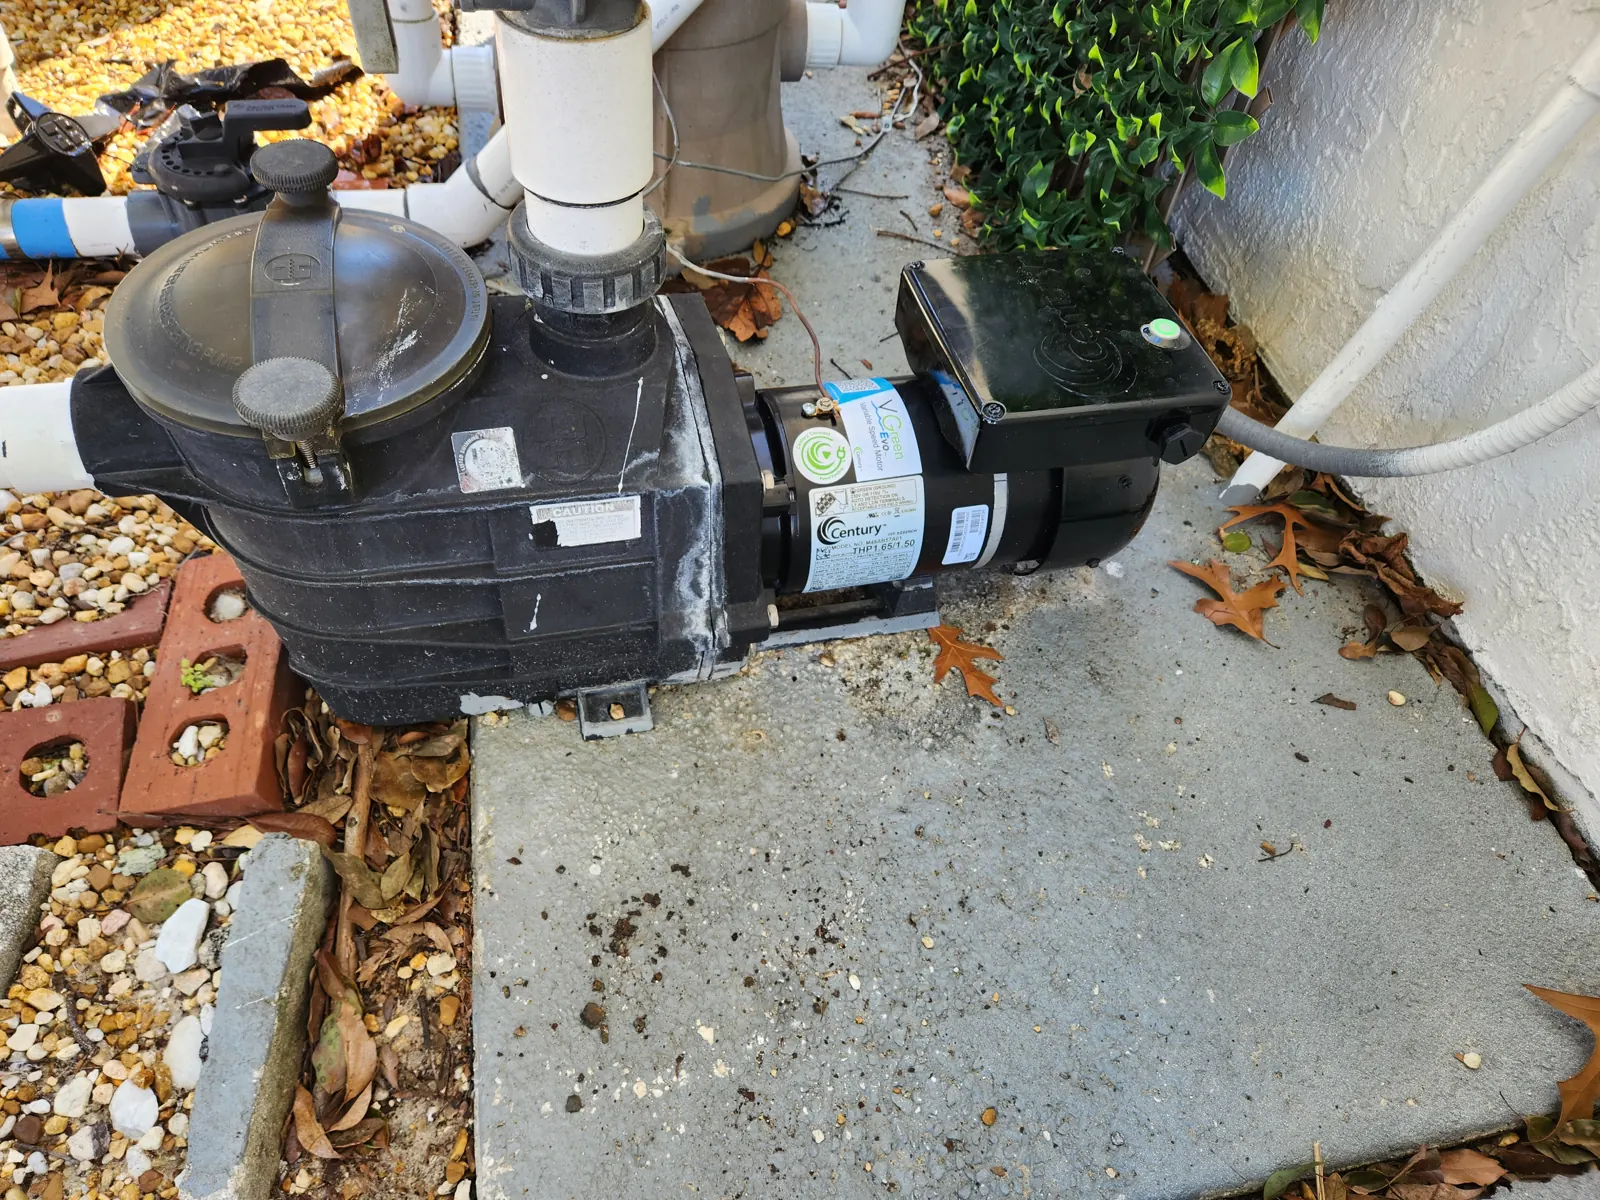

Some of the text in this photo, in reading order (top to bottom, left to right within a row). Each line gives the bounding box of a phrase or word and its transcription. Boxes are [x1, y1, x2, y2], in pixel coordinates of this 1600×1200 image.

[200, 347, 245, 372] PUMP
[859, 402, 884, 472] Variable Speed Motor
[879, 432, 890, 452] Evo
[552, 503, 615, 517] CAUTION
[831, 524, 882, 540] Century
